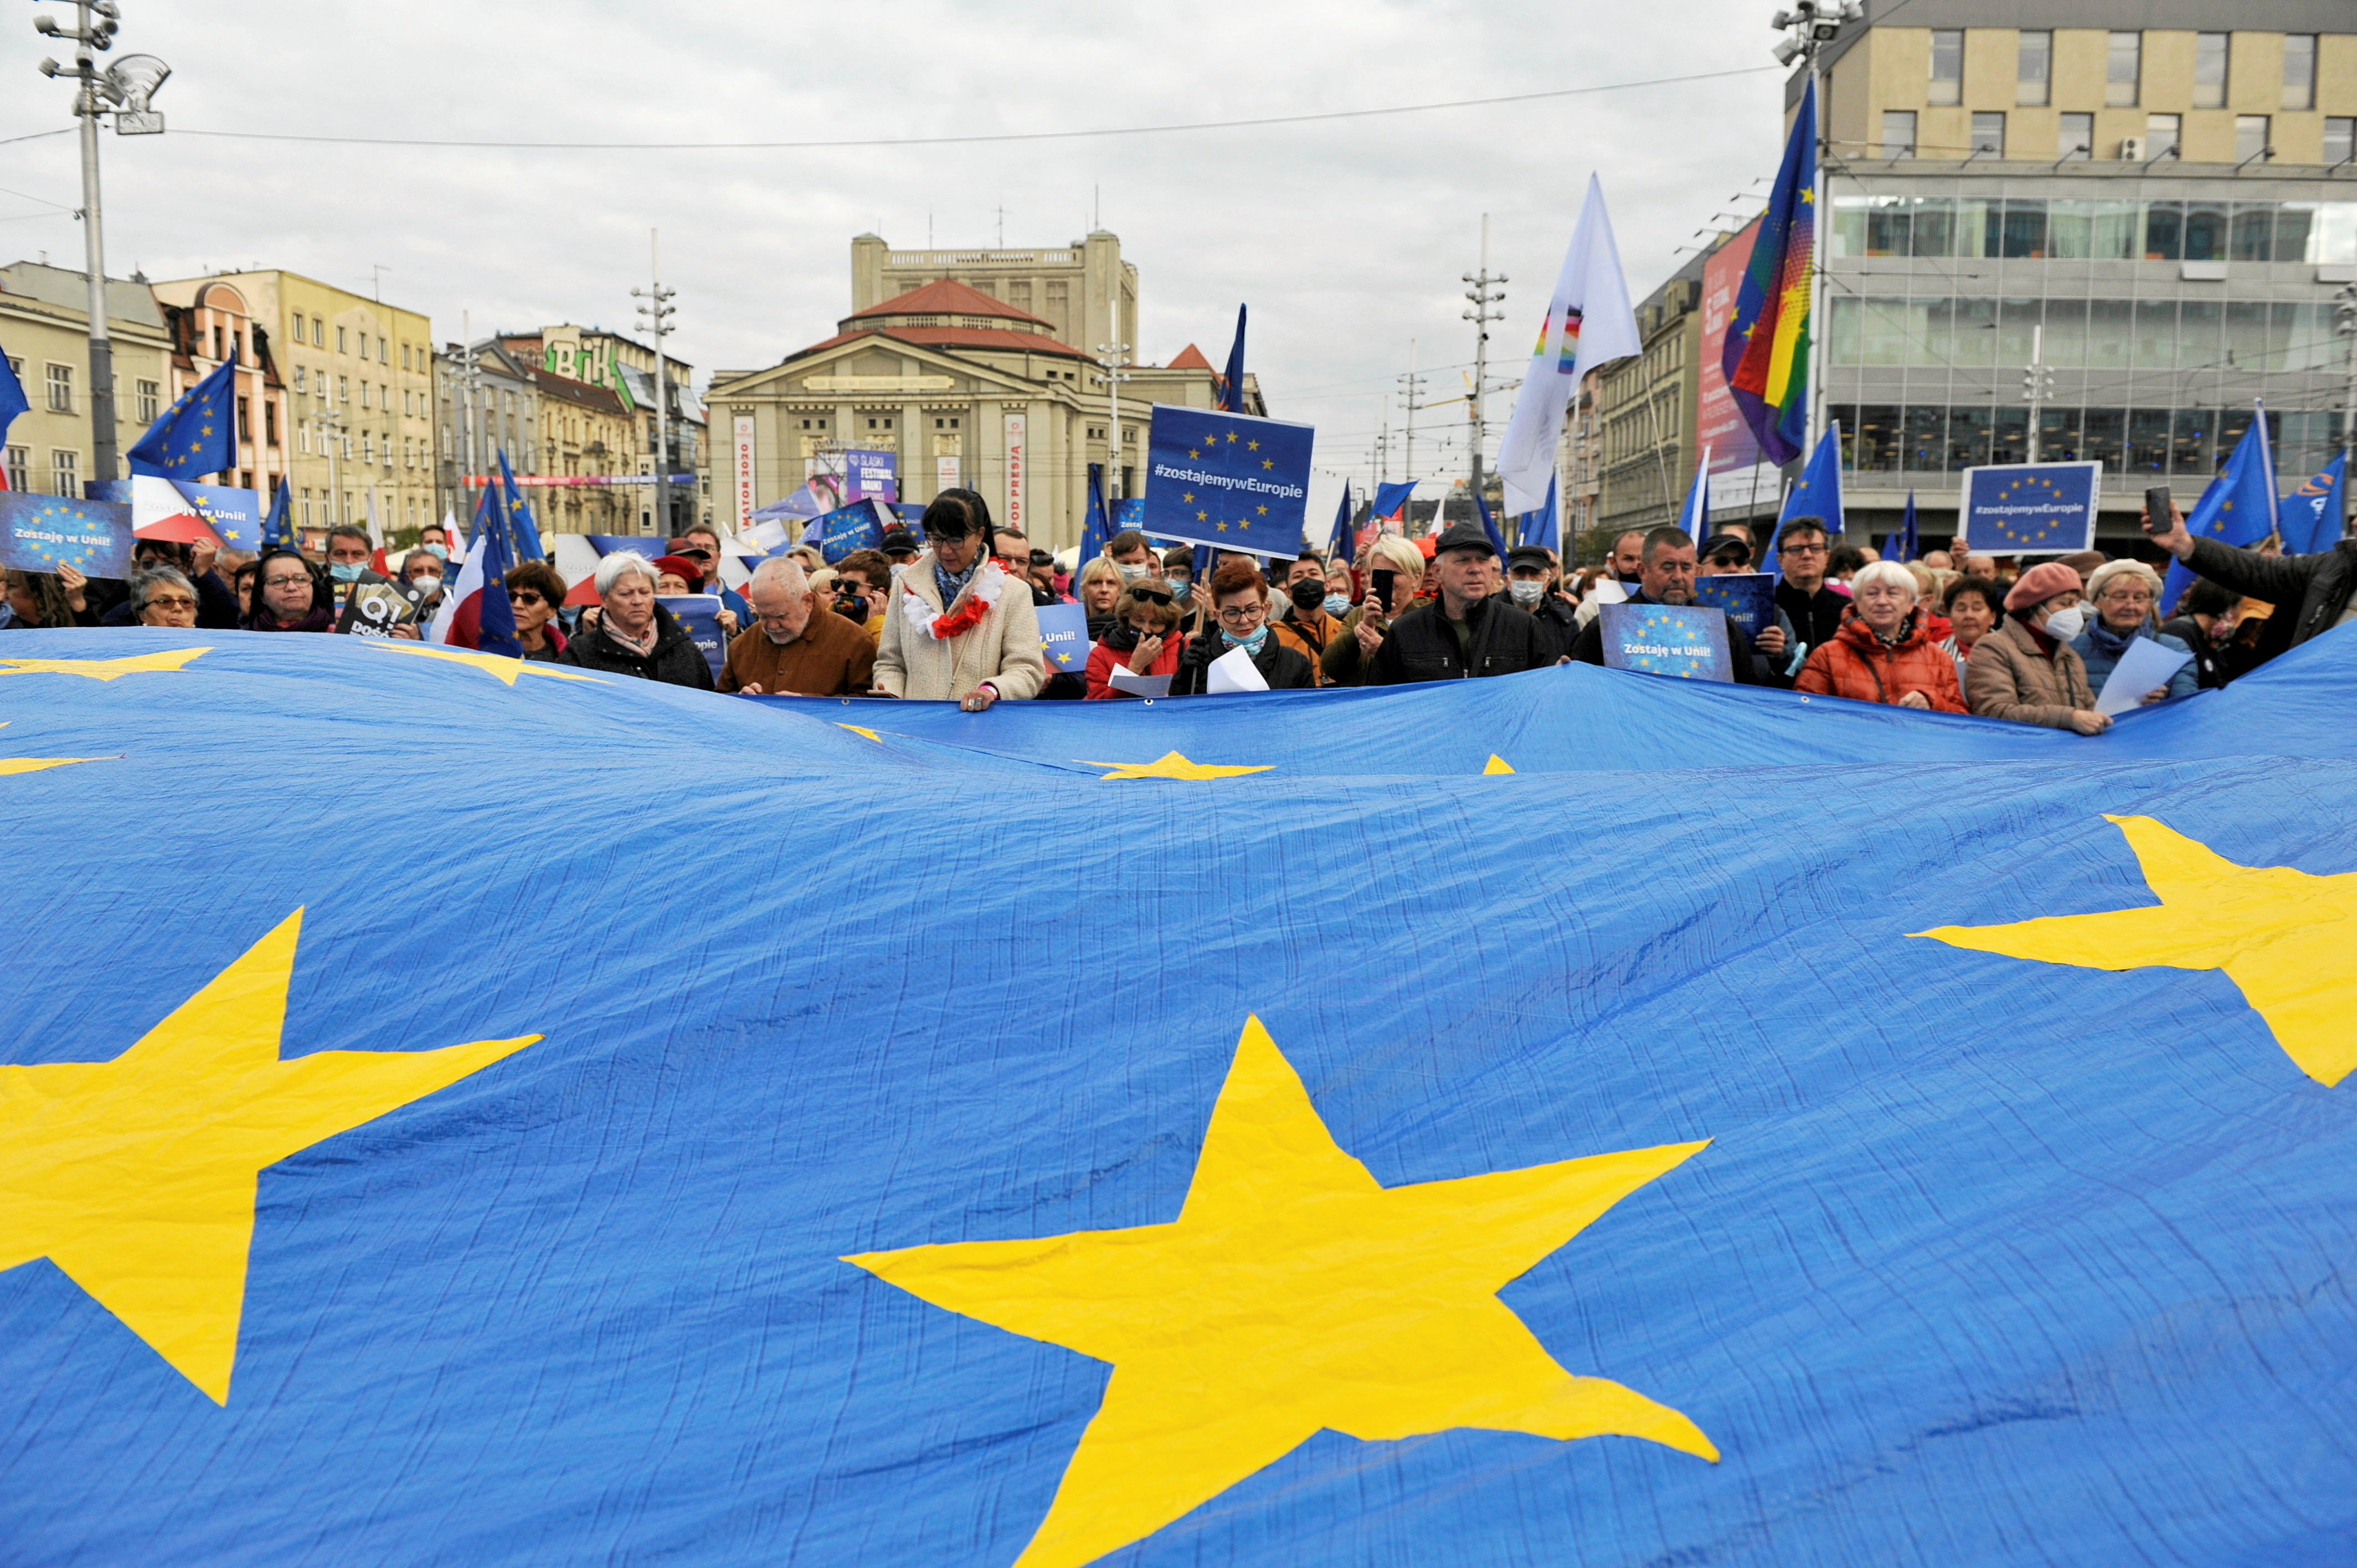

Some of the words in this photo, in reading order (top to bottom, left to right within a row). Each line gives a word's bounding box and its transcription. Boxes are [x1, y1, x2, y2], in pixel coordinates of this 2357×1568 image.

[741, 443, 749, 477] 2020
[1155, 463, 1303, 498] #zostajemywEuropie
[199, 508, 212, 517] w
[215, 509, 247, 522] Unii!
[742, 481, 750, 532] MATOR
[1011, 502, 1020, 530] POD
[1975, 503, 2085, 515] #zostajemywEuropie
[14, 528, 64, 544] Zostaję
[66, 535, 79, 543] w
[80, 534, 111, 546] Unii!
[822, 530, 848, 545] Zostaję
[855, 522, 871, 533] Unii!
[361, 596, 403, 630] Q!
[1731, 612, 1754, 622] nii!
[1045, 631, 1075, 642] Unii!
[1624, 643, 1669, 657] Zostaję
[1671, 647, 1682, 656] w
[1684, 646, 1711, 657] Unii!
